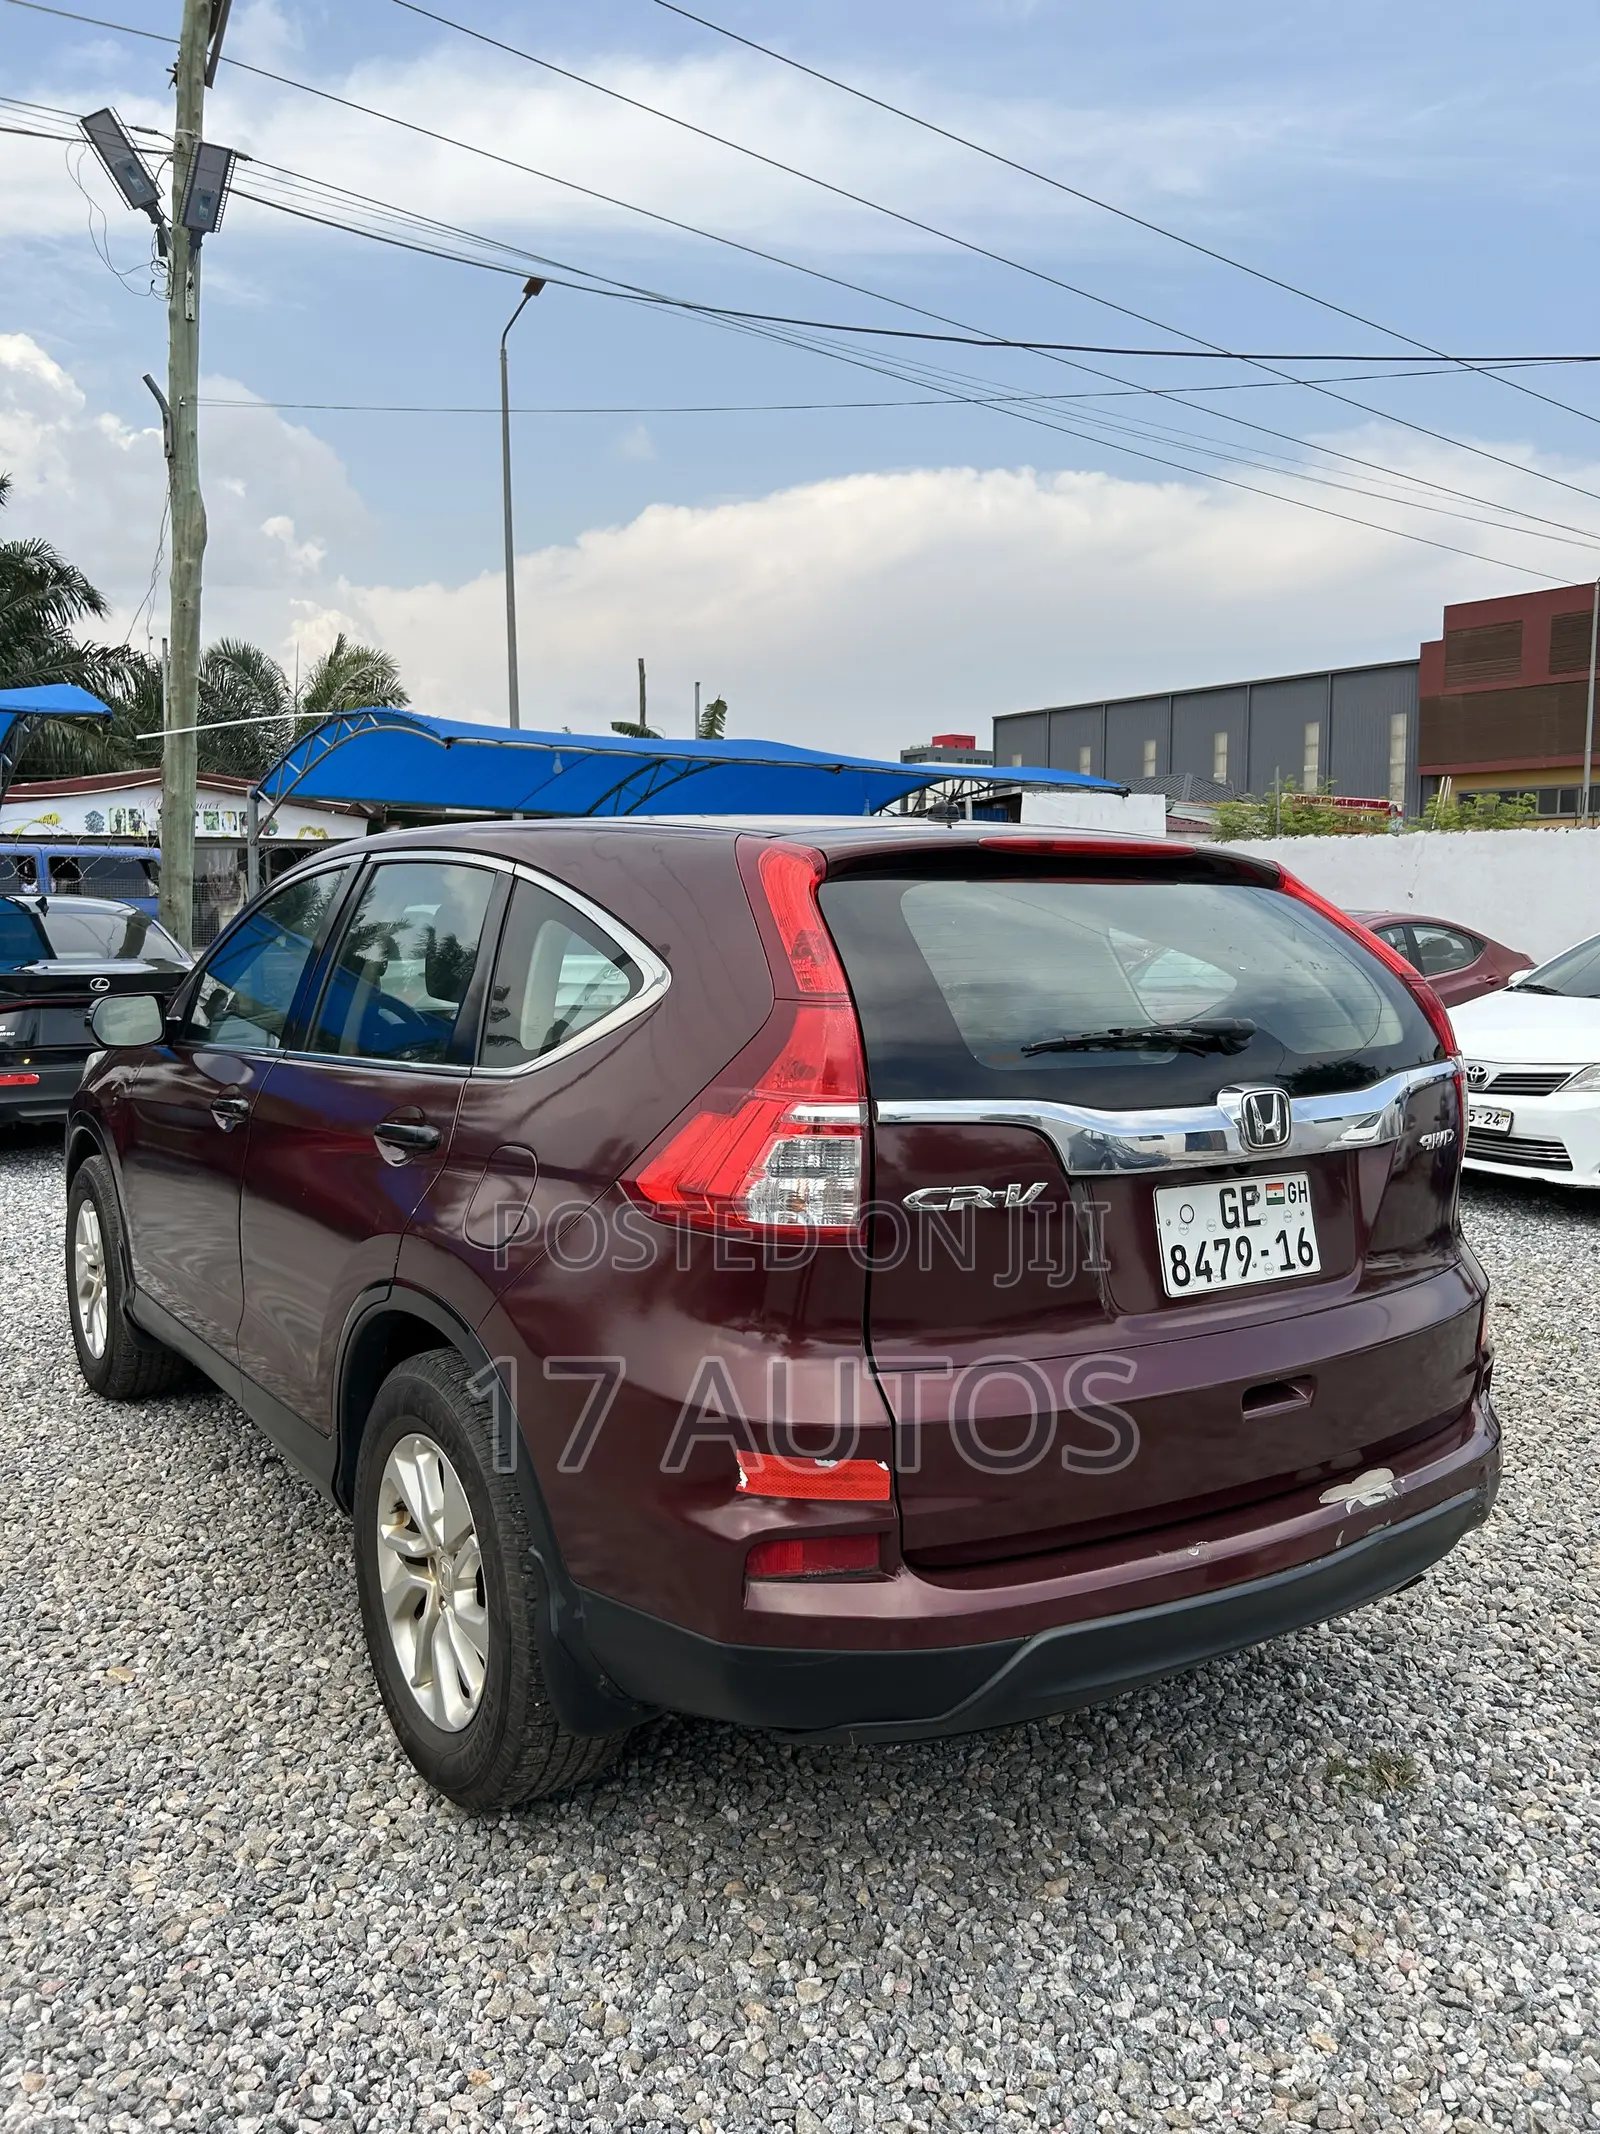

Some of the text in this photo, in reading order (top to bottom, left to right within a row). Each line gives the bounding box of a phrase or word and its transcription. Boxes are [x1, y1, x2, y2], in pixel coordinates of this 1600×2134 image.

[902, 1182, 1049, 1212] CR-V
[1219, 1181, 1308, 1230] GE GH
[1170, 1227, 1314, 1287] 8479-16
